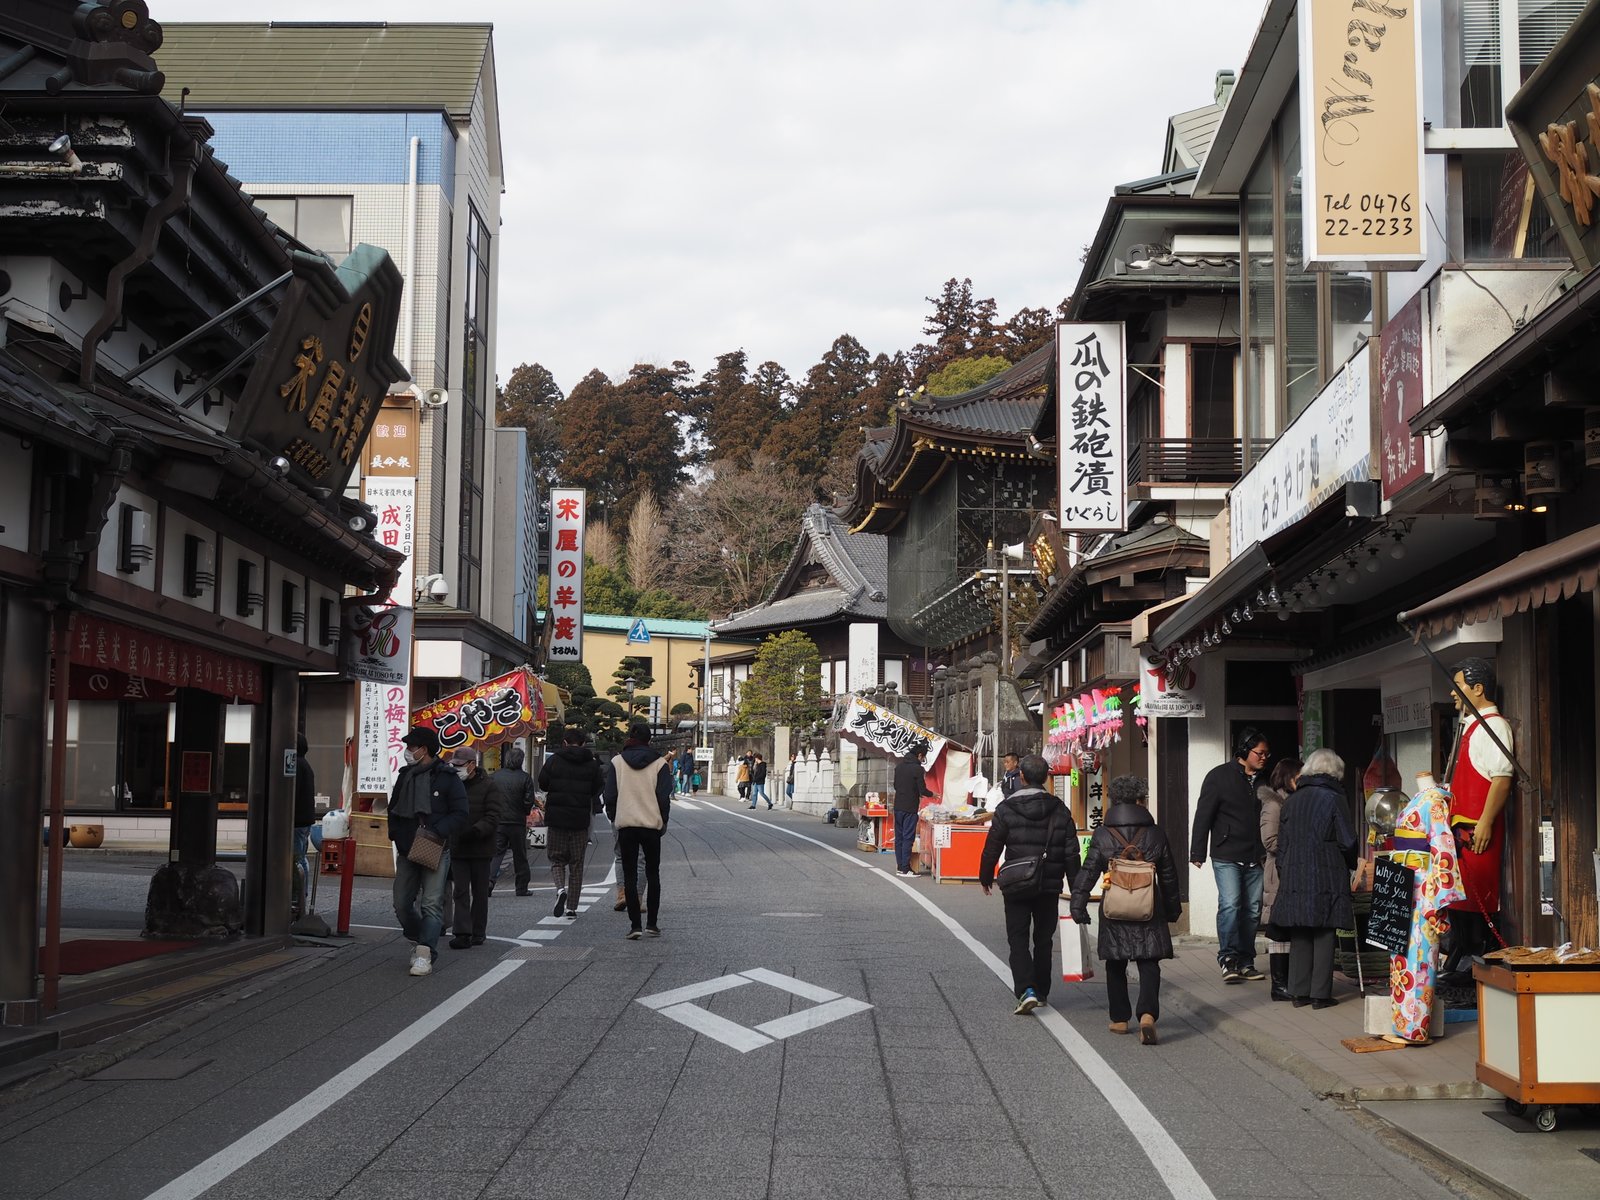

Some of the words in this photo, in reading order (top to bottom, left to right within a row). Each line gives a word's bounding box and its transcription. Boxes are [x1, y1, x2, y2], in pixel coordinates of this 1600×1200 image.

[1323, 193, 1352, 213] Tel
[1360, 193, 1412, 213] 0476
[1324, 217, 1413, 236] 22-2233
[1069, 331, 1114, 496] 瓜の鉄砲漬
[1065, 501, 1118, 522] ひぐらし
[433, 688, 522, 748] こやき
[1375, 865, 1394, 882] Why
[1394, 870, 1406, 884] do
[1374, 882, 1390, 895] not
